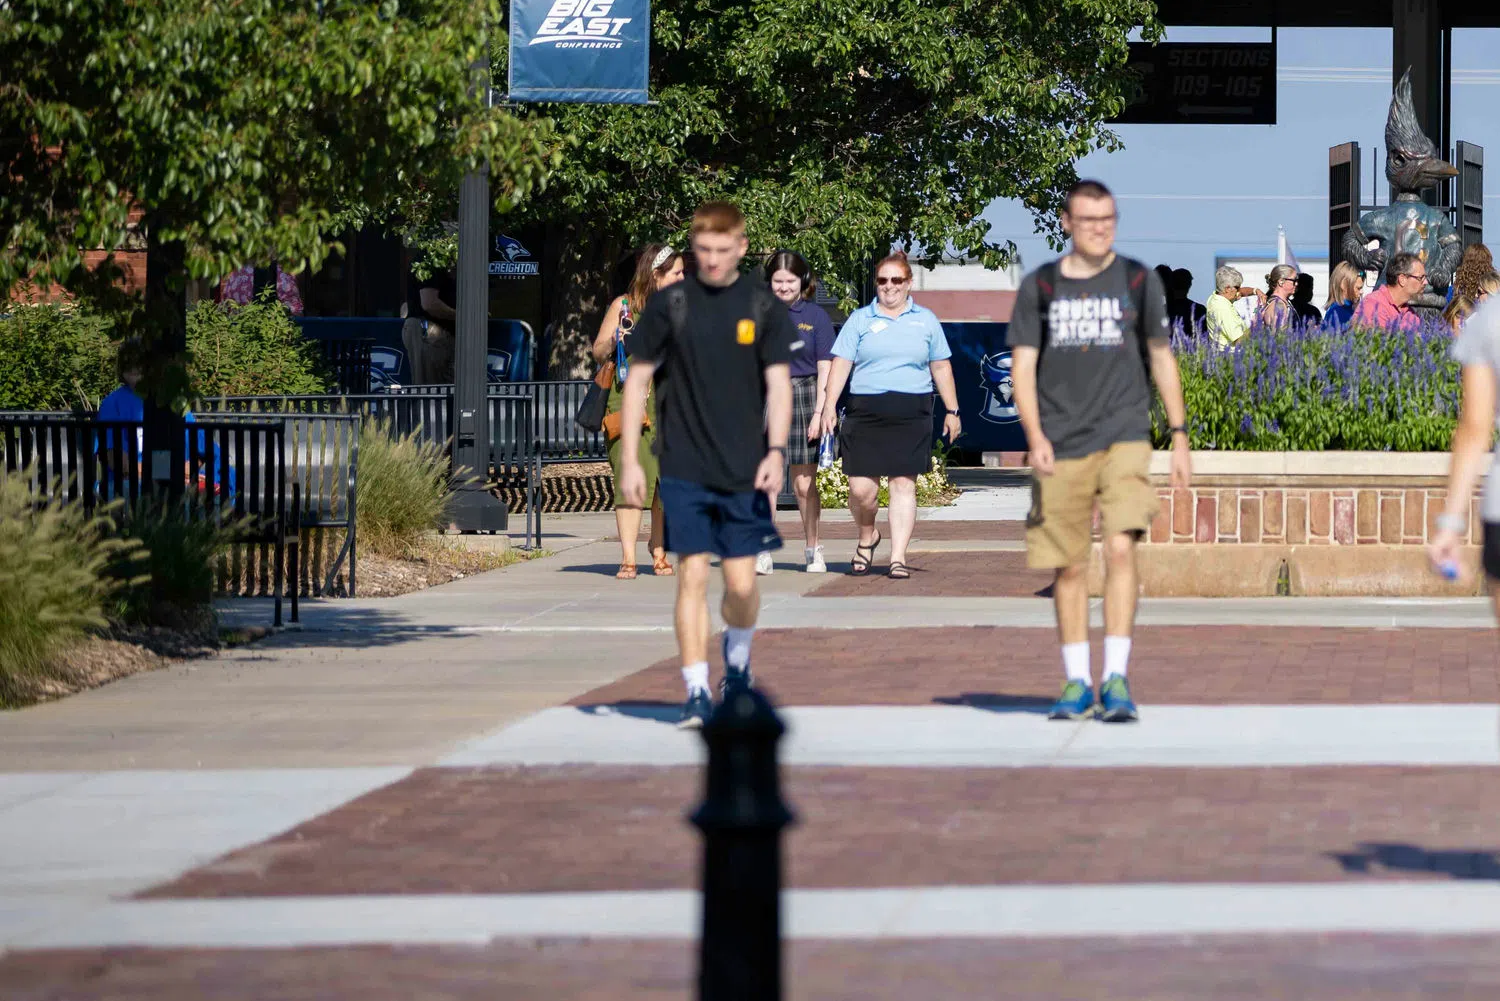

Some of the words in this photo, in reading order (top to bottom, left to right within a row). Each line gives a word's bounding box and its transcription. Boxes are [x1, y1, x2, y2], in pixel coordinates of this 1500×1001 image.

[536, 17, 633, 36] EAST
[554, 41, 624, 49] CONFERENCE
[1167, 48, 1271, 67] SECTIONS
[1172, 74, 1263, 97] 109-105
[488, 262, 538, 273] CREIGHTON
